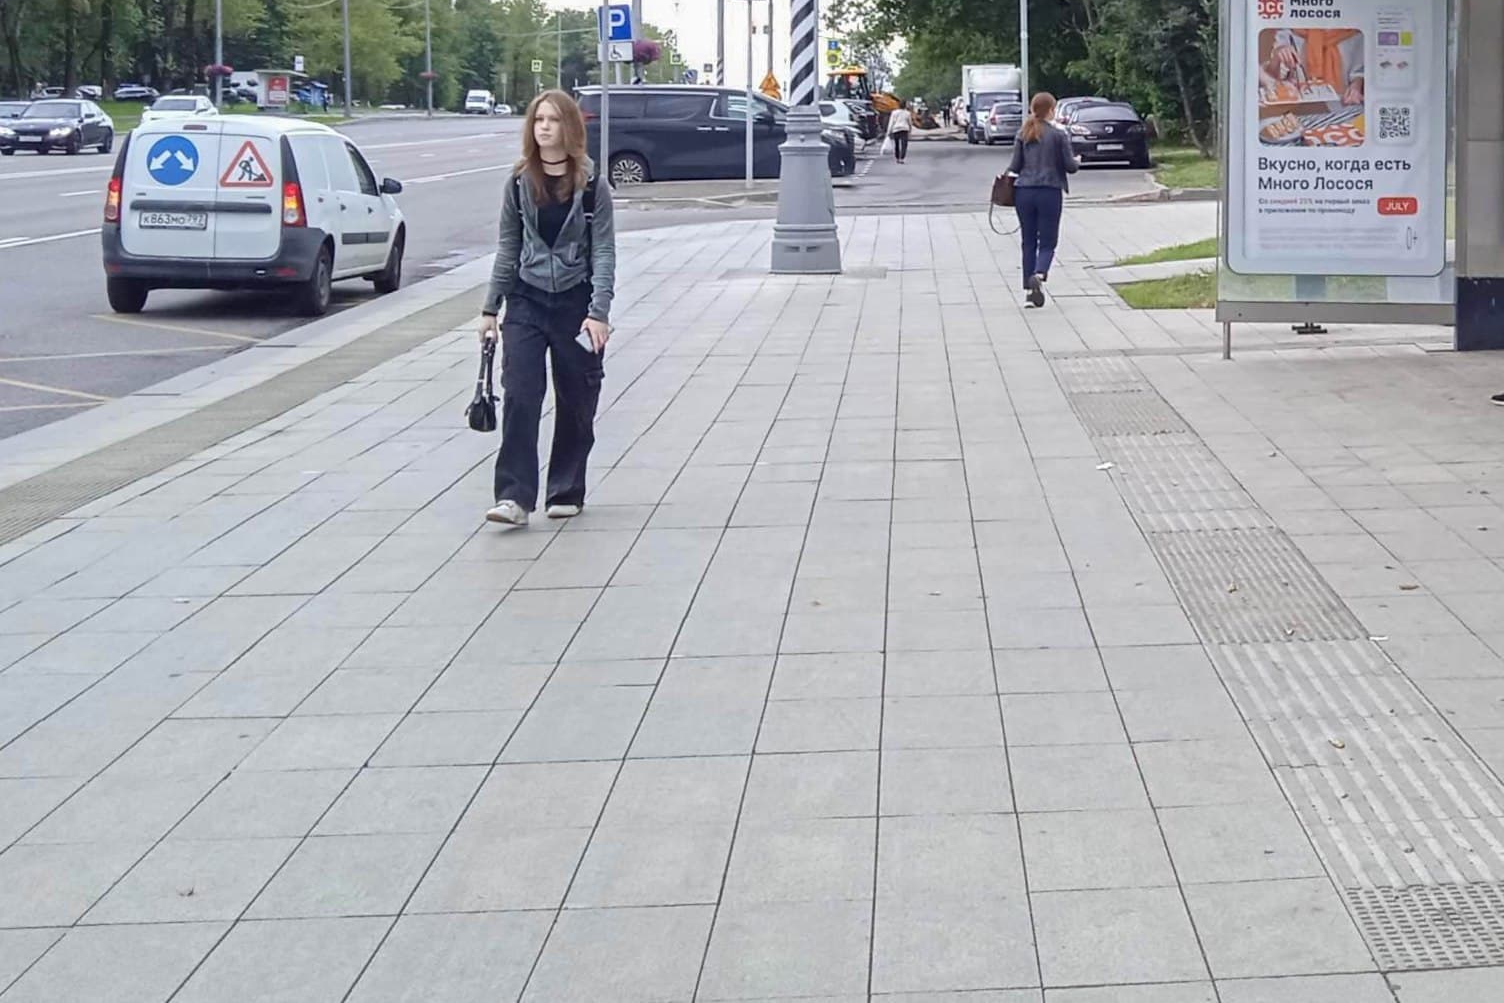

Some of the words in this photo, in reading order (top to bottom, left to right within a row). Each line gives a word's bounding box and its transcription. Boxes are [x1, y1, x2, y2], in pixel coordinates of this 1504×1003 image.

[1290, 9, 1341, 19] лосося
[608, 9, 625, 37] P
[1258, 157, 1321, 173] Вкусно,
[1325, 159, 1370, 173] когда
[1375, 159, 1411, 171] есть
[1258, 177, 1309, 190] Много
[1314, 177, 1373, 190] Лосося
[1385, 202, 1409, 211] JULY
